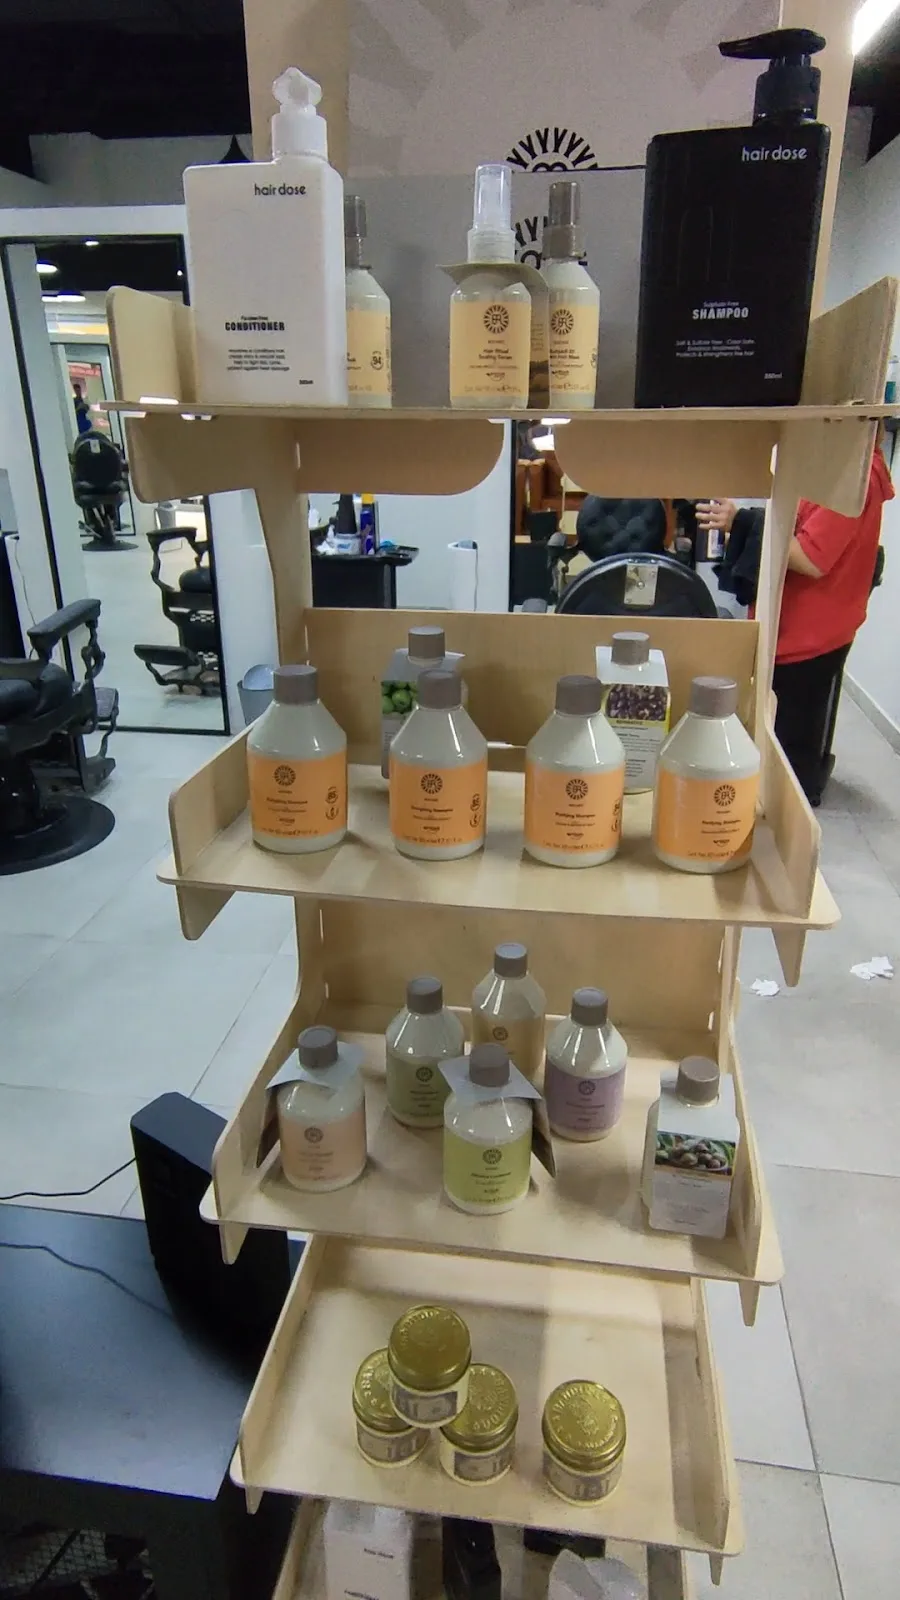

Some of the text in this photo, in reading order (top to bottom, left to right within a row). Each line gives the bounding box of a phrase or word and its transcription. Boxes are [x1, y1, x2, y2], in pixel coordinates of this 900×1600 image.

[742, 145, 807, 161] hair dose
[254, 183, 306, 196] hair dose
[692, 307, 749, 319] SHAMPOO
[225, 322, 285, 331] CONDITIONER
